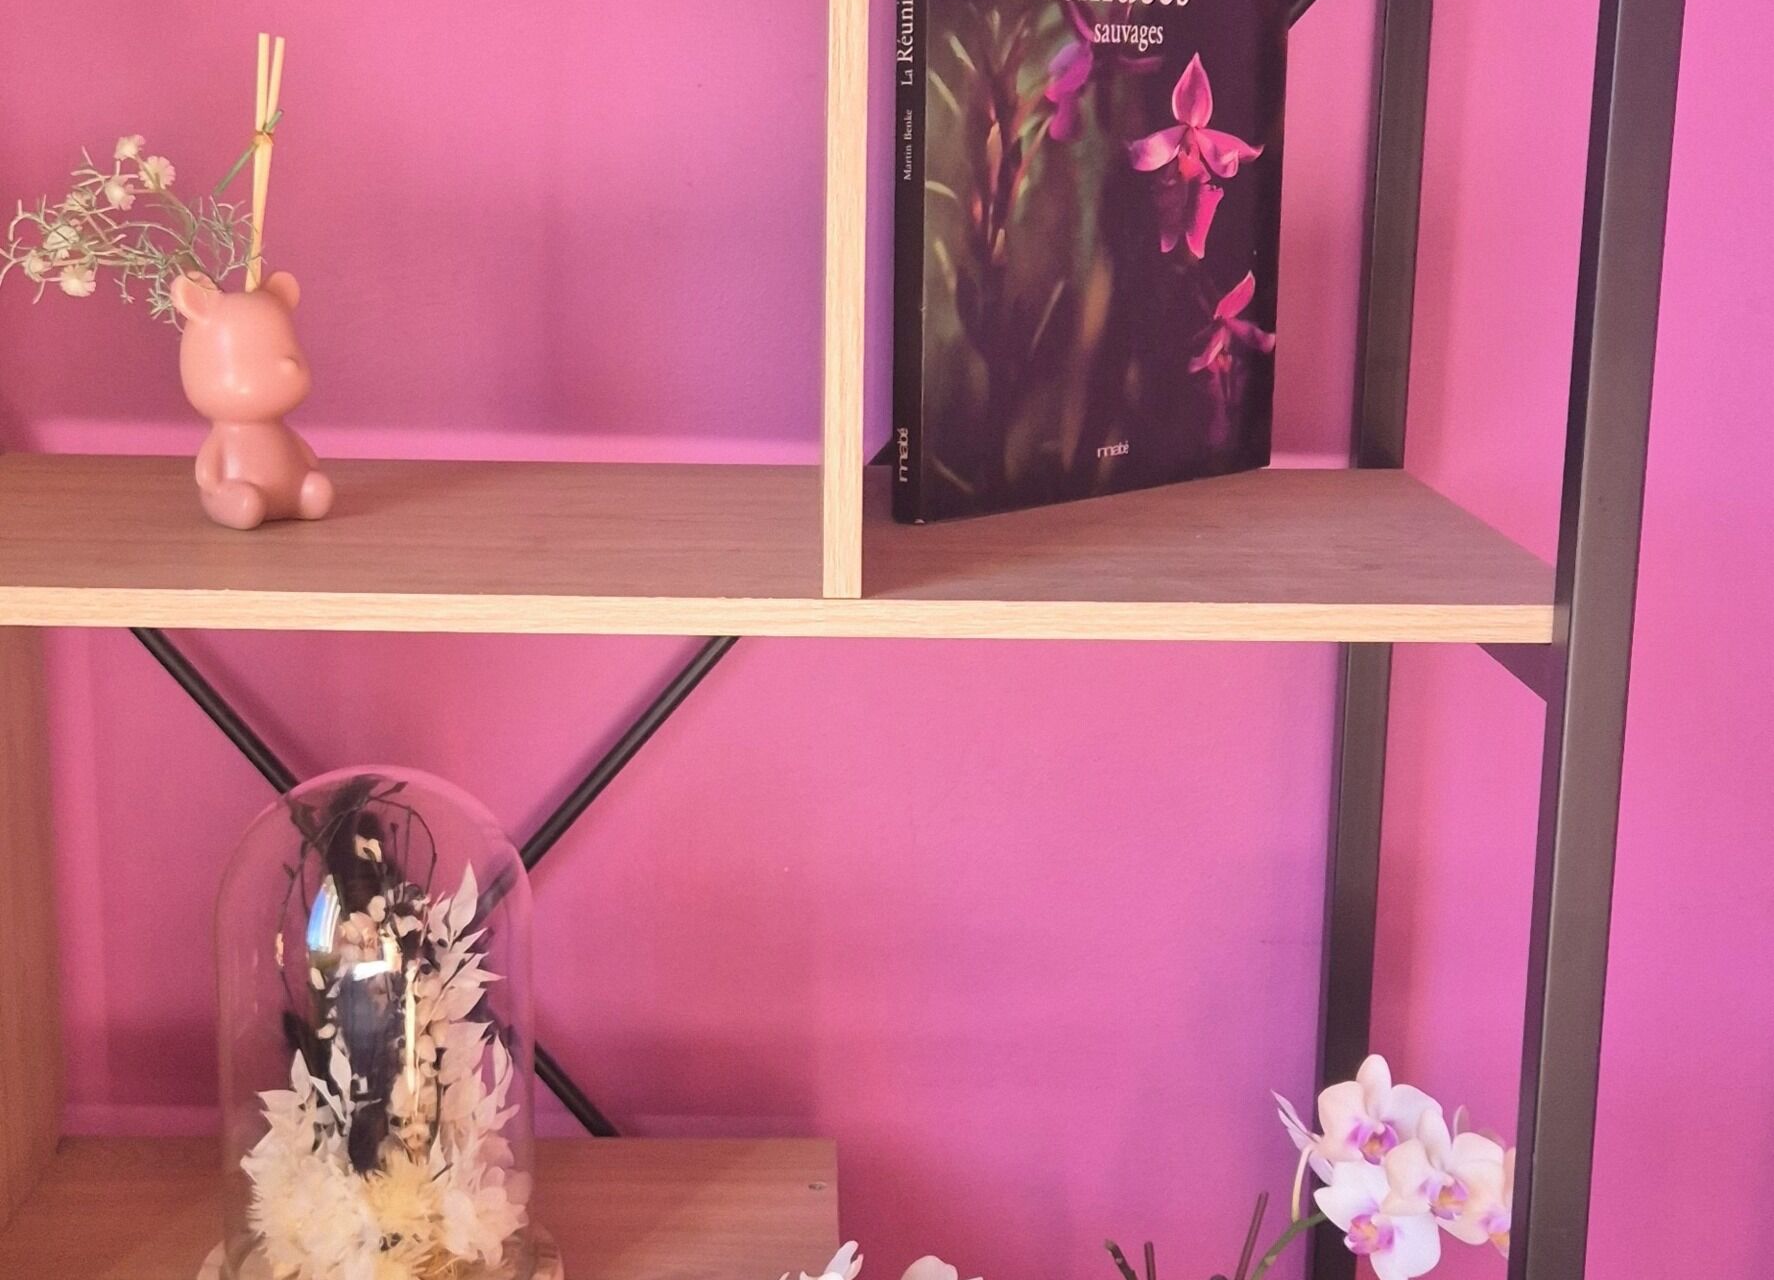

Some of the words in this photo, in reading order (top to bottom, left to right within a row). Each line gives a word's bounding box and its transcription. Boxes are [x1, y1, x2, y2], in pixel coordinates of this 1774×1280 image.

[1093, 22, 1164, 53] sauvages
[901, 70, 914, 86] La
[903, 145, 913, 181] Martin
